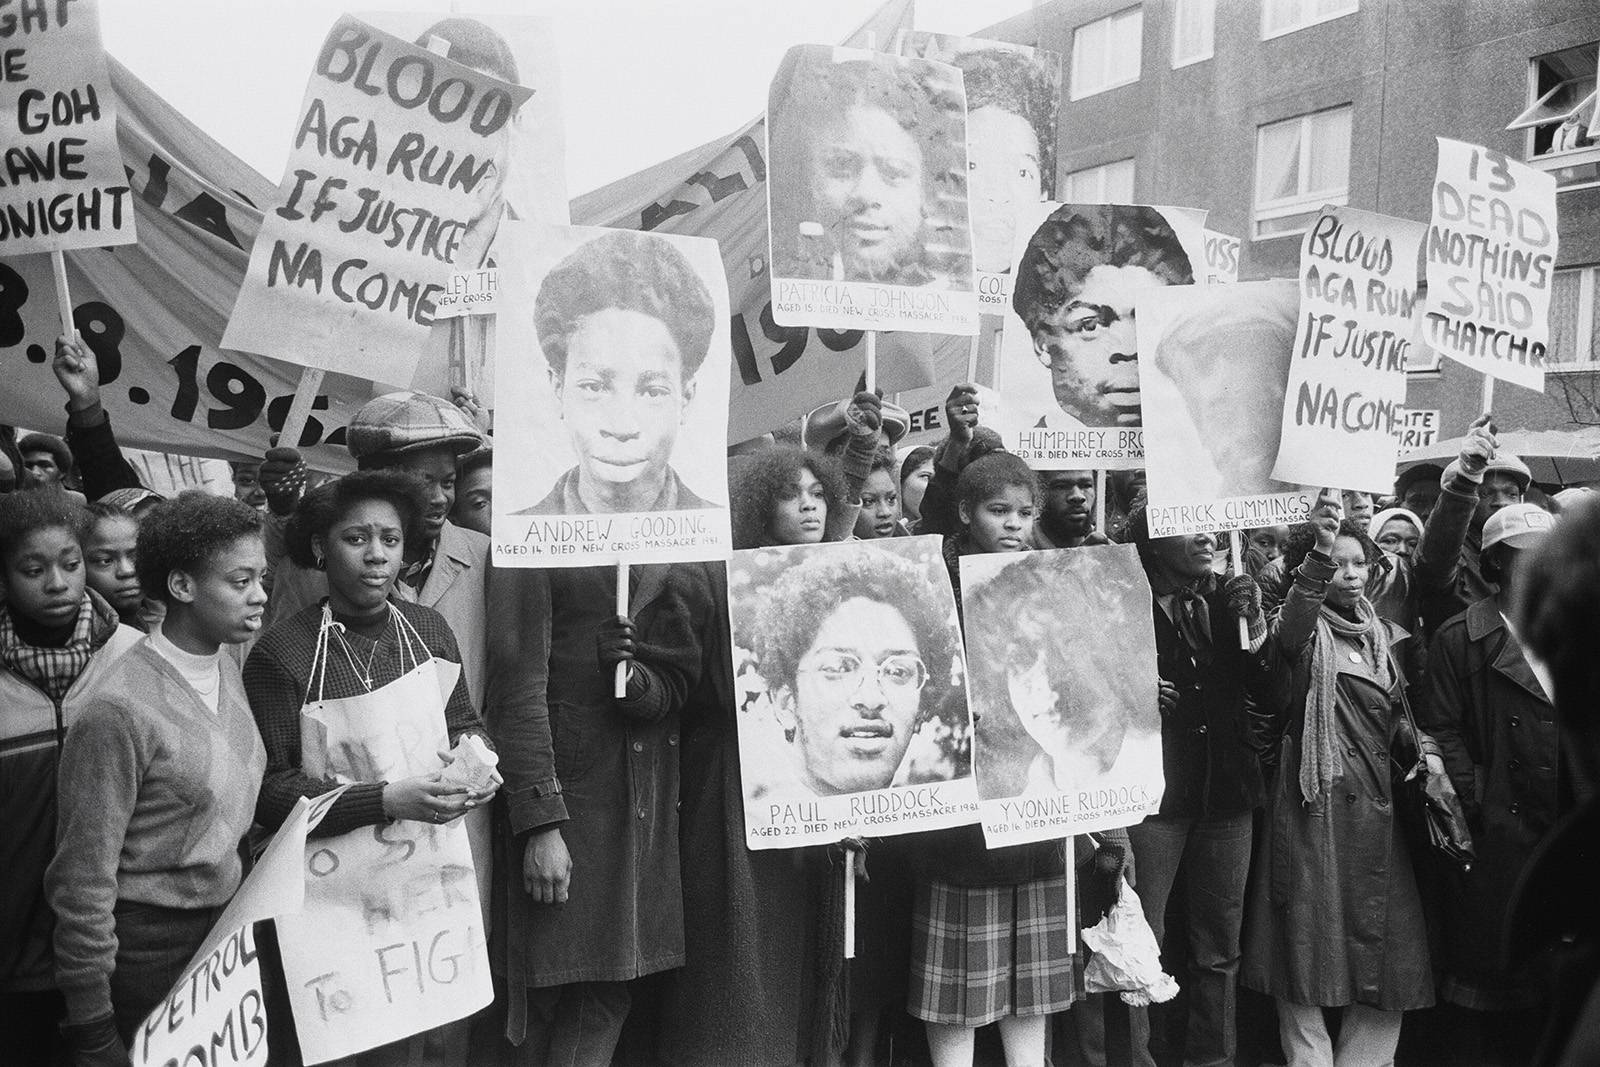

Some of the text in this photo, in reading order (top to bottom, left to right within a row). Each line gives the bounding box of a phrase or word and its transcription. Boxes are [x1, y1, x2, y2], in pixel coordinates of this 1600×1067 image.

[0, 48, 29, 83] E
[18, 83, 101, 136] GOH
[0, 137, 88, 188] AVE
[386, 131, 493, 194] RUN
[1469, 148, 1516, 193] 13
[1436, 180, 1551, 248] DEAD
[1308, 214, 1393, 277] BLOOD
[331, 257, 447, 327] COME
[441, 274, 471, 296] LEY
[462, 292, 493, 304] CROSS
[779, 281, 854, 305] PATRICIA
[776, 302, 802, 313] AGED
[820, 304, 839, 315] DIED
[842, 305, 864, 317] NEW
[867, 307, 896, 319] CROSS
[899, 310, 944, 322] MASSACRE
[1019, 430, 1106, 450] HUMPHREY
[1048, 449, 1068, 459] DIED
[1071, 449, 1092, 459] NEW
[1095, 448, 1123, 459] CROSS
[1150, 494, 1311, 527] PATRICK CUMMINGS
[524, 518, 613, 543] ANDREW
[1153, 526, 1177, 537] AGED
[1196, 523, 1215, 532] DIED
[1219, 520, 1239, 531] NEW
[1243, 518, 1271, 528] CROSS
[495, 544, 528, 555] AGED
[550, 544, 576, 555] DIED
[582, 542, 605, 553] NEW
[611, 540, 640, 551] CROSS
[644, 536, 697, 549] MASSACRE
[750, 826, 781, 838] AGED
[804, 823, 829, 834] DIED
[833, 819, 859, 831] NEW
[863, 813, 899, 826] CROSS
[902, 805, 957, 821] MASSACRE
[769, 802, 827, 825] PAUL
[986, 823, 1009, 834] AGED
[1025, 819, 1046, 830] DIED
[1049, 816, 1068, 826] NEW
[1073, 811, 1100, 823] CROSS
[1103, 803, 1147, 818] MASSACRE
[1000, 794, 1071, 822] YVONNE
[141, 925, 258, 1065] PETROL
[162, 989, 265, 1067] MB
